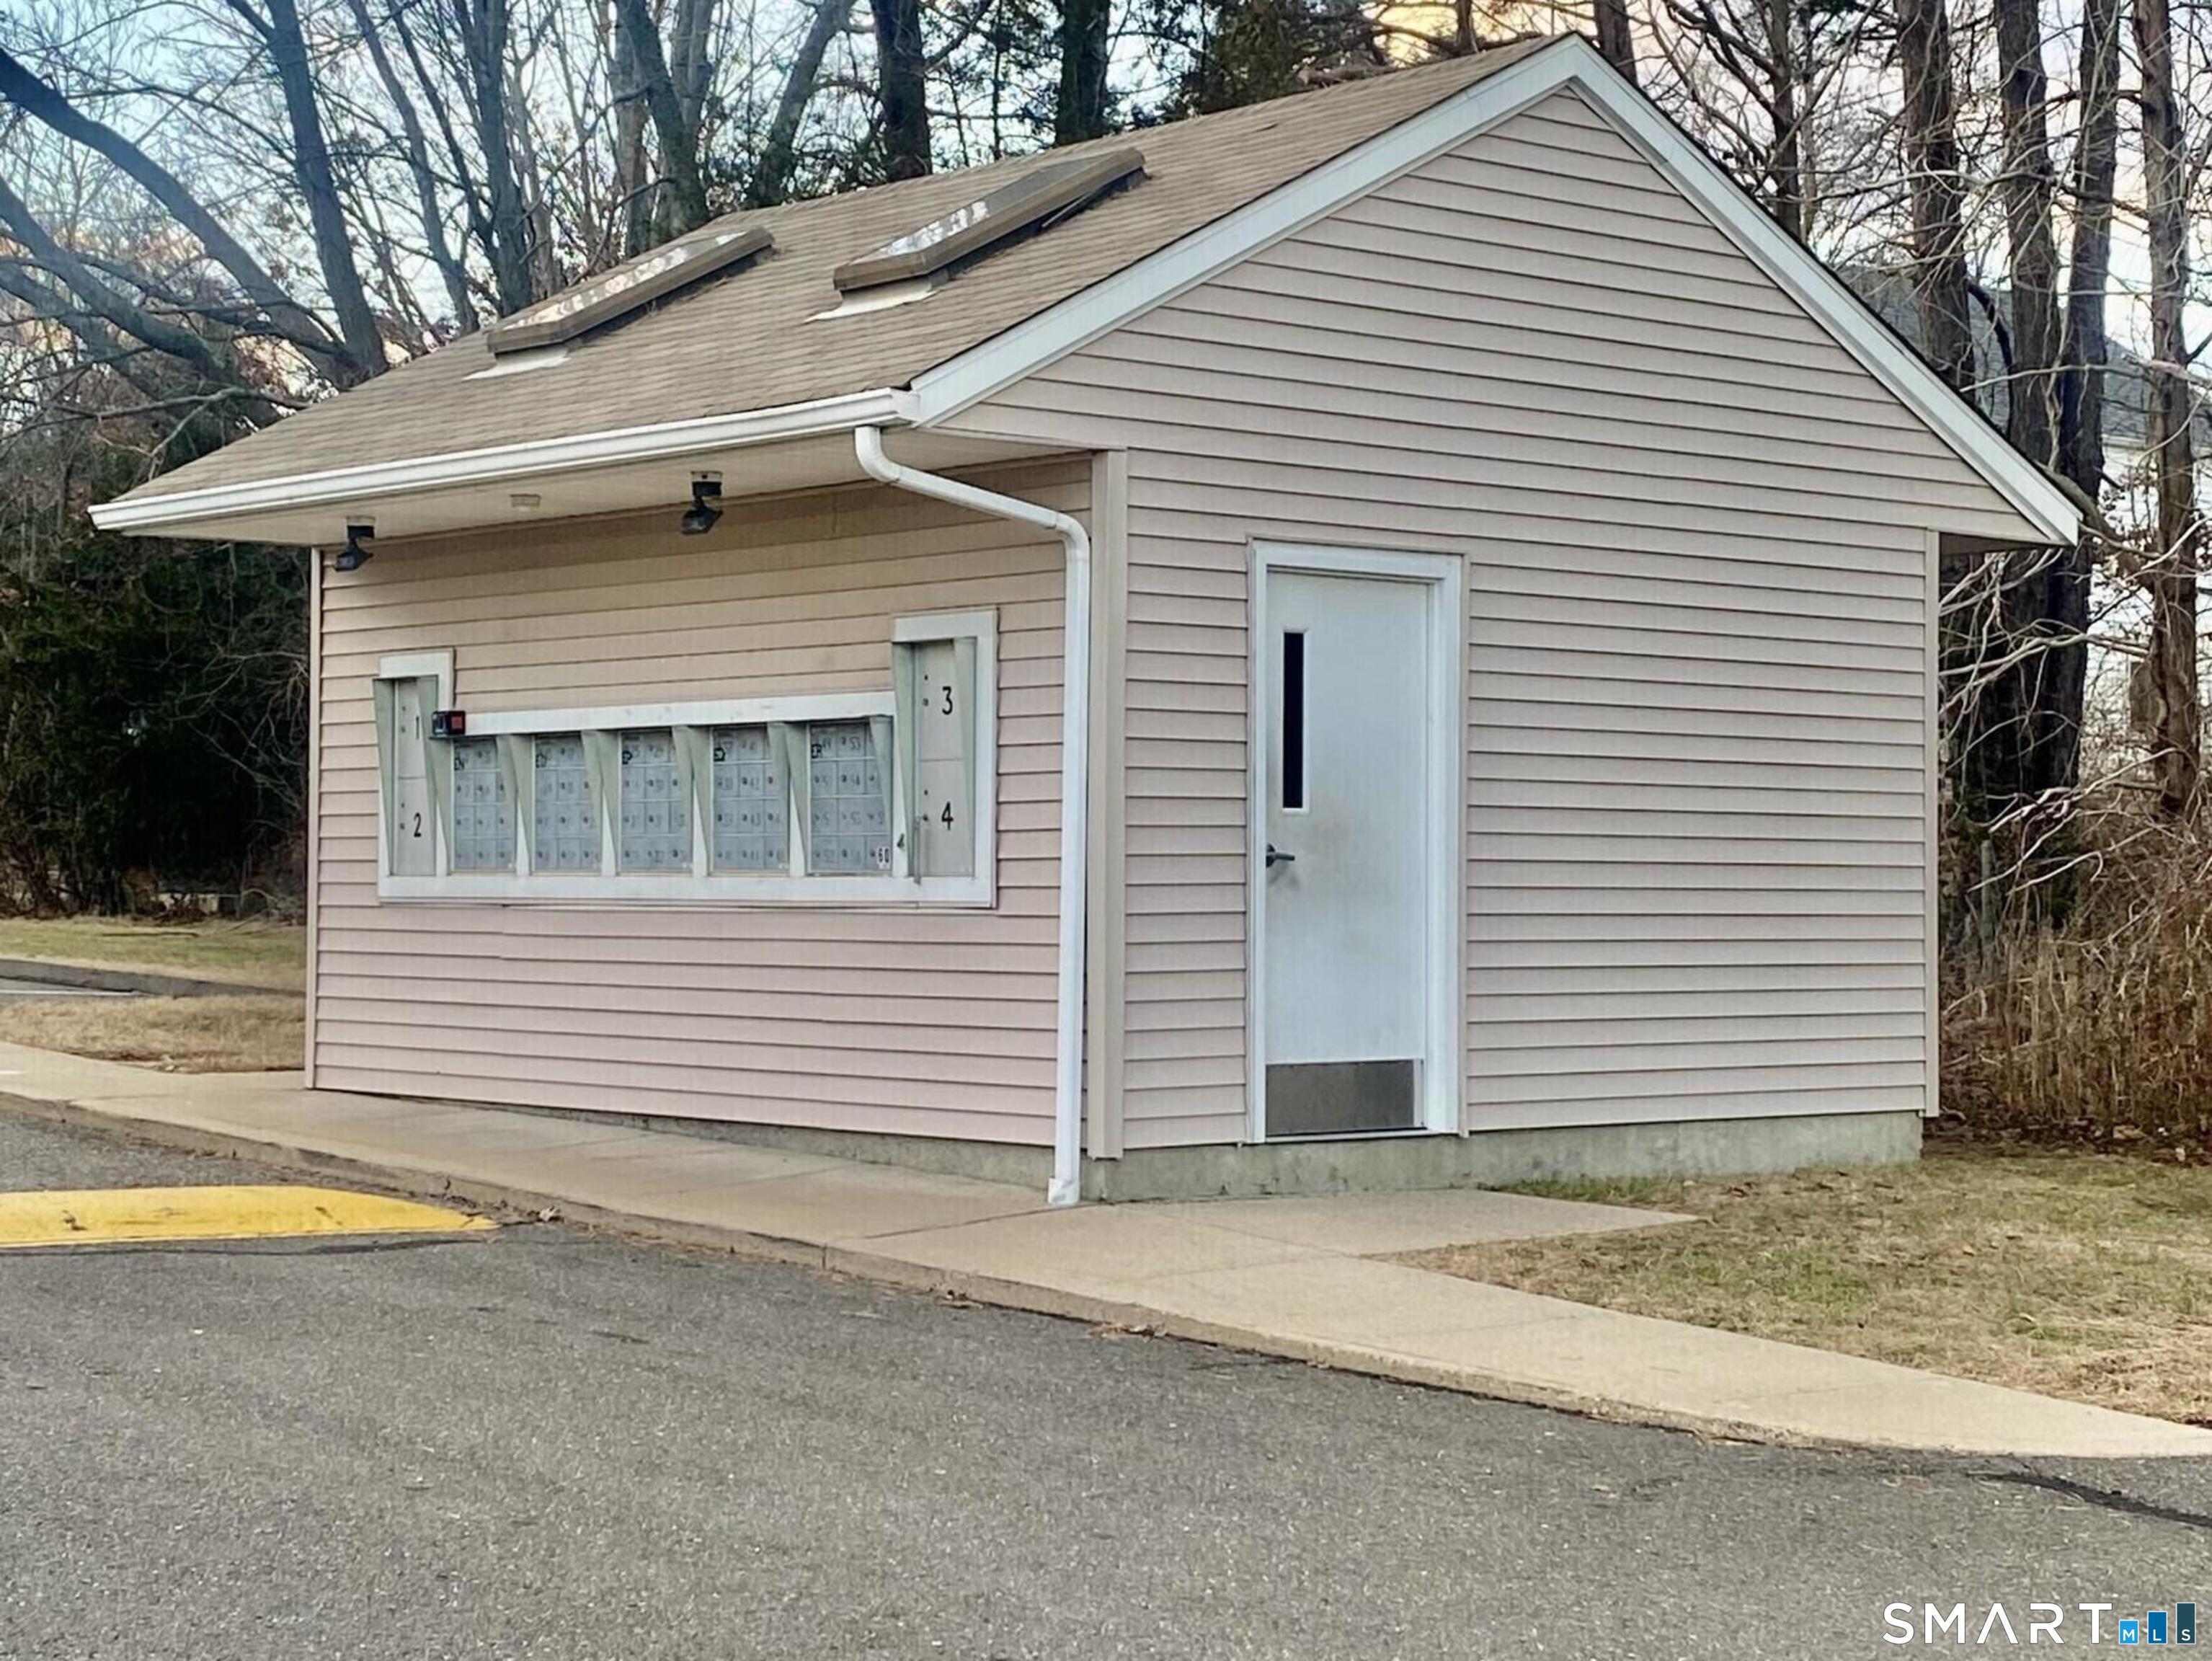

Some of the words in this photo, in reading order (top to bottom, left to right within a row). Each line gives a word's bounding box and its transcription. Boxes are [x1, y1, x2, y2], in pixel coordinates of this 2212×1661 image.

[941, 686, 954, 715] 3
[415, 716, 420, 740] 1
[413, 812, 422, 838] 2
[941, 801, 954, 830] 4
[879, 848, 889, 863] 60
